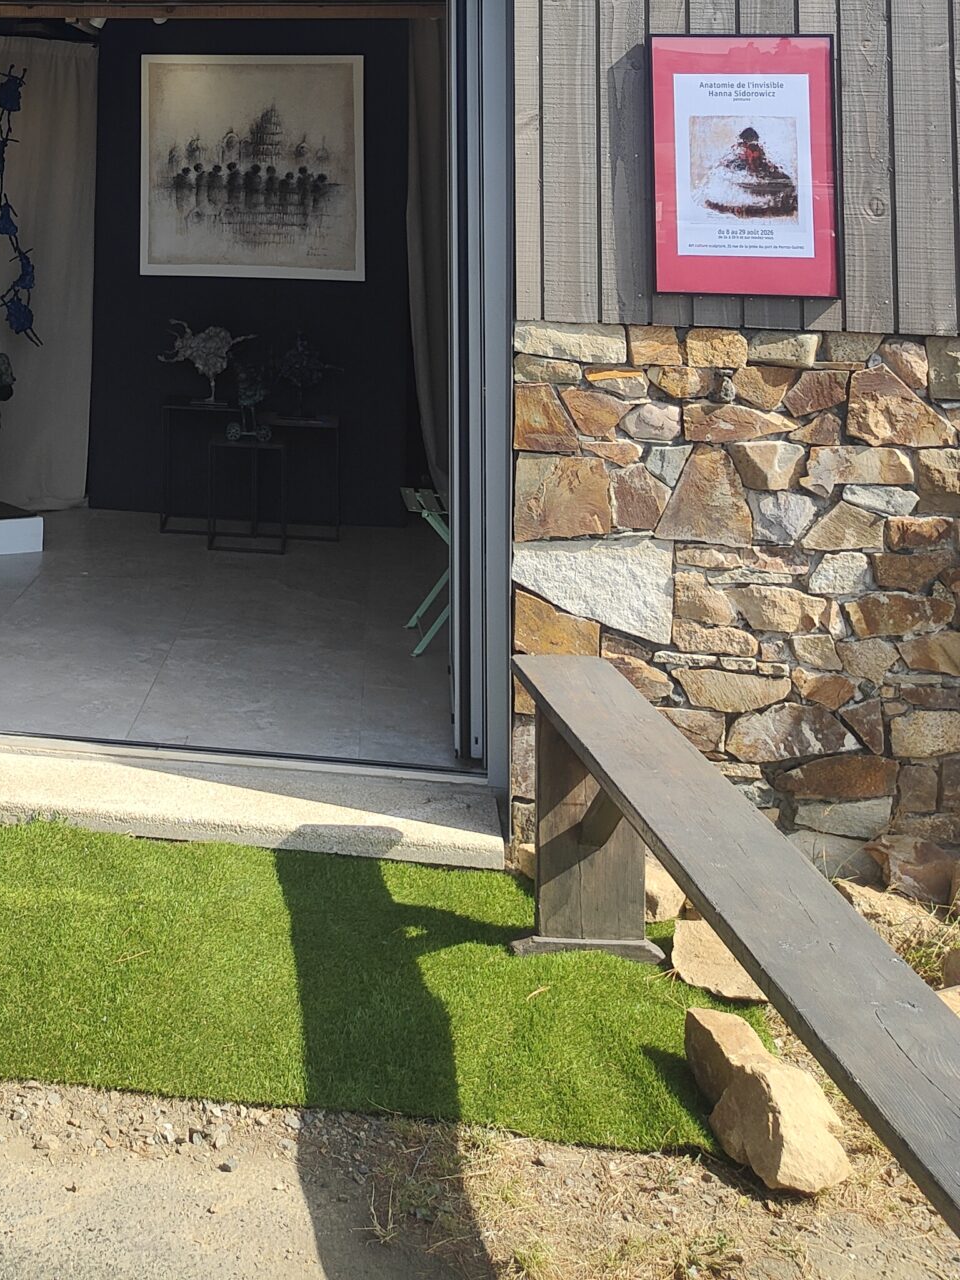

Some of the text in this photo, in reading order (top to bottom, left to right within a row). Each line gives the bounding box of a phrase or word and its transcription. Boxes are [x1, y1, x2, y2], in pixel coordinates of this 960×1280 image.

[699, 81, 784, 89] Anatomie de l'invisible
